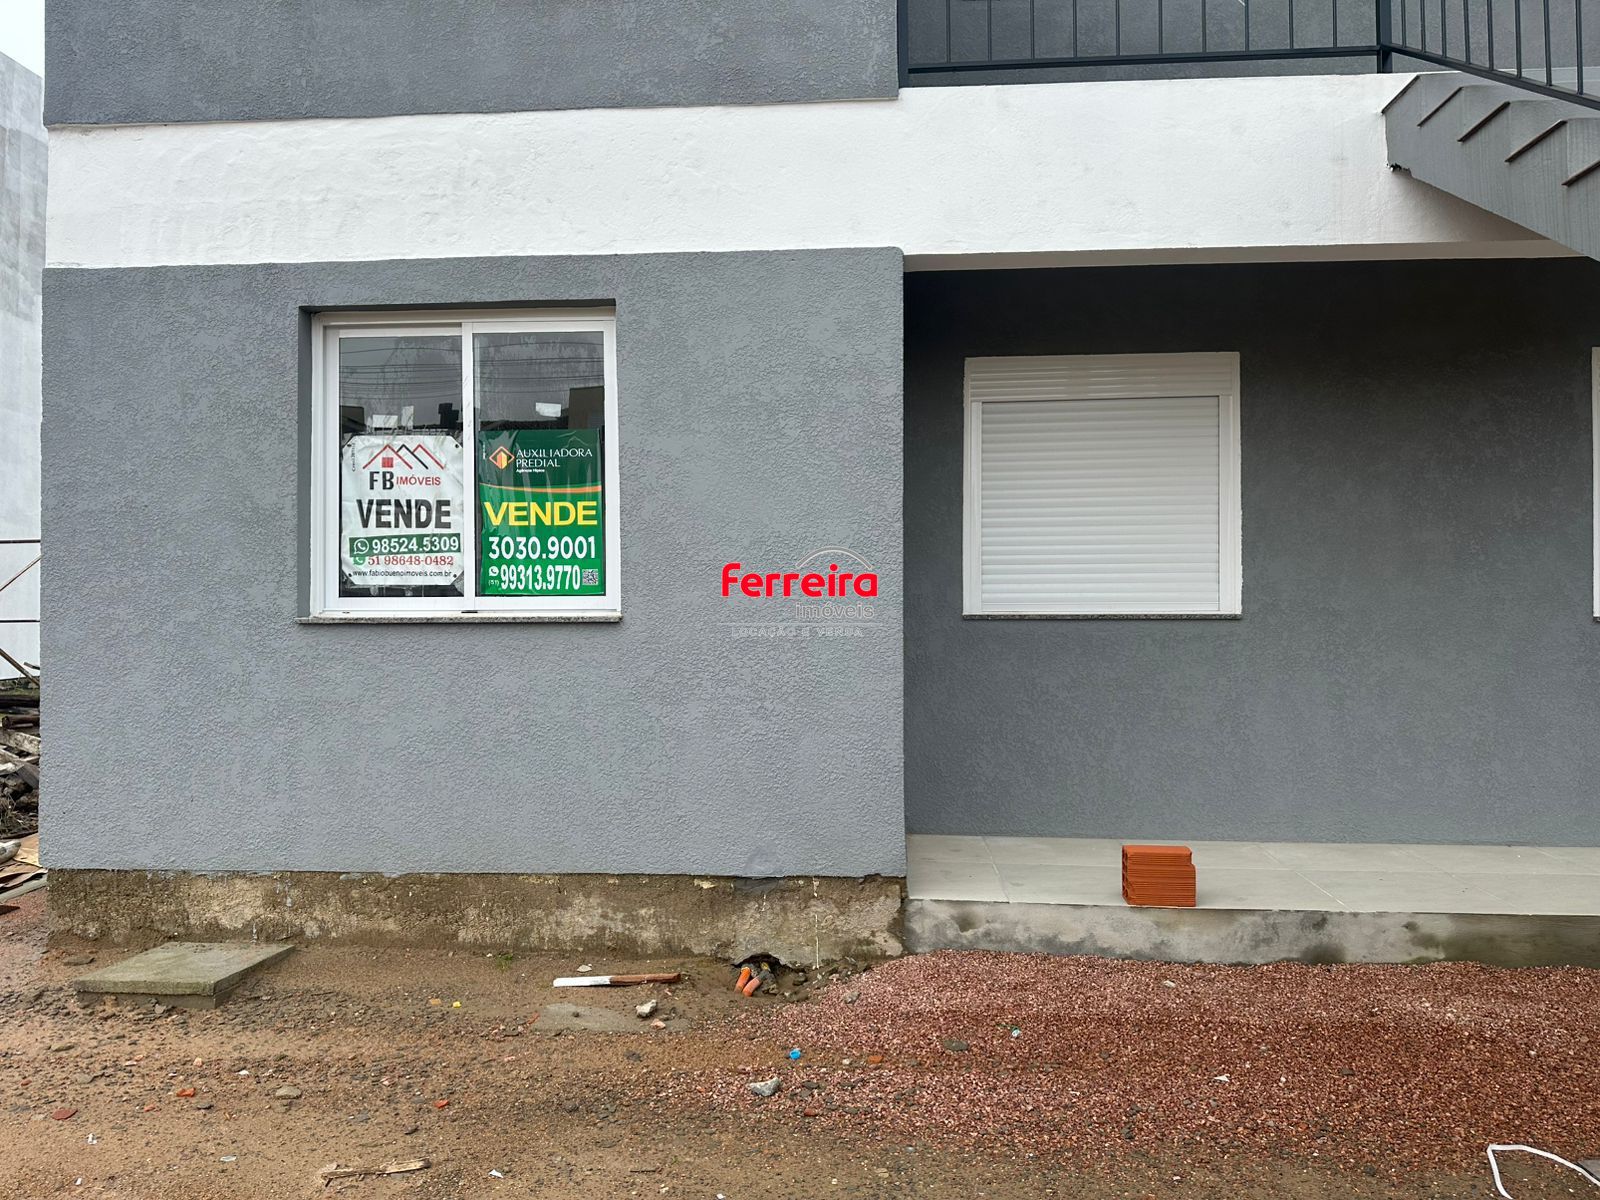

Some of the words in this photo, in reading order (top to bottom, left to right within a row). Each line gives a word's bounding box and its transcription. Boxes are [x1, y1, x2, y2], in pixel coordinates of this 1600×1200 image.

[516, 448, 593, 458] AUXILIADORA
[516, 459, 560, 468] PREDIAL
[369, 471, 394, 490] FB
[396, 475, 442, 486] IMÓVEIS
[356, 499, 451, 528] VENDE
[484, 501, 597, 526] VENDE
[372, 536, 459, 554] 98524.5309
[488, 536, 596, 559] 3030.9001
[500, 564, 581, 590] 99313.9770
